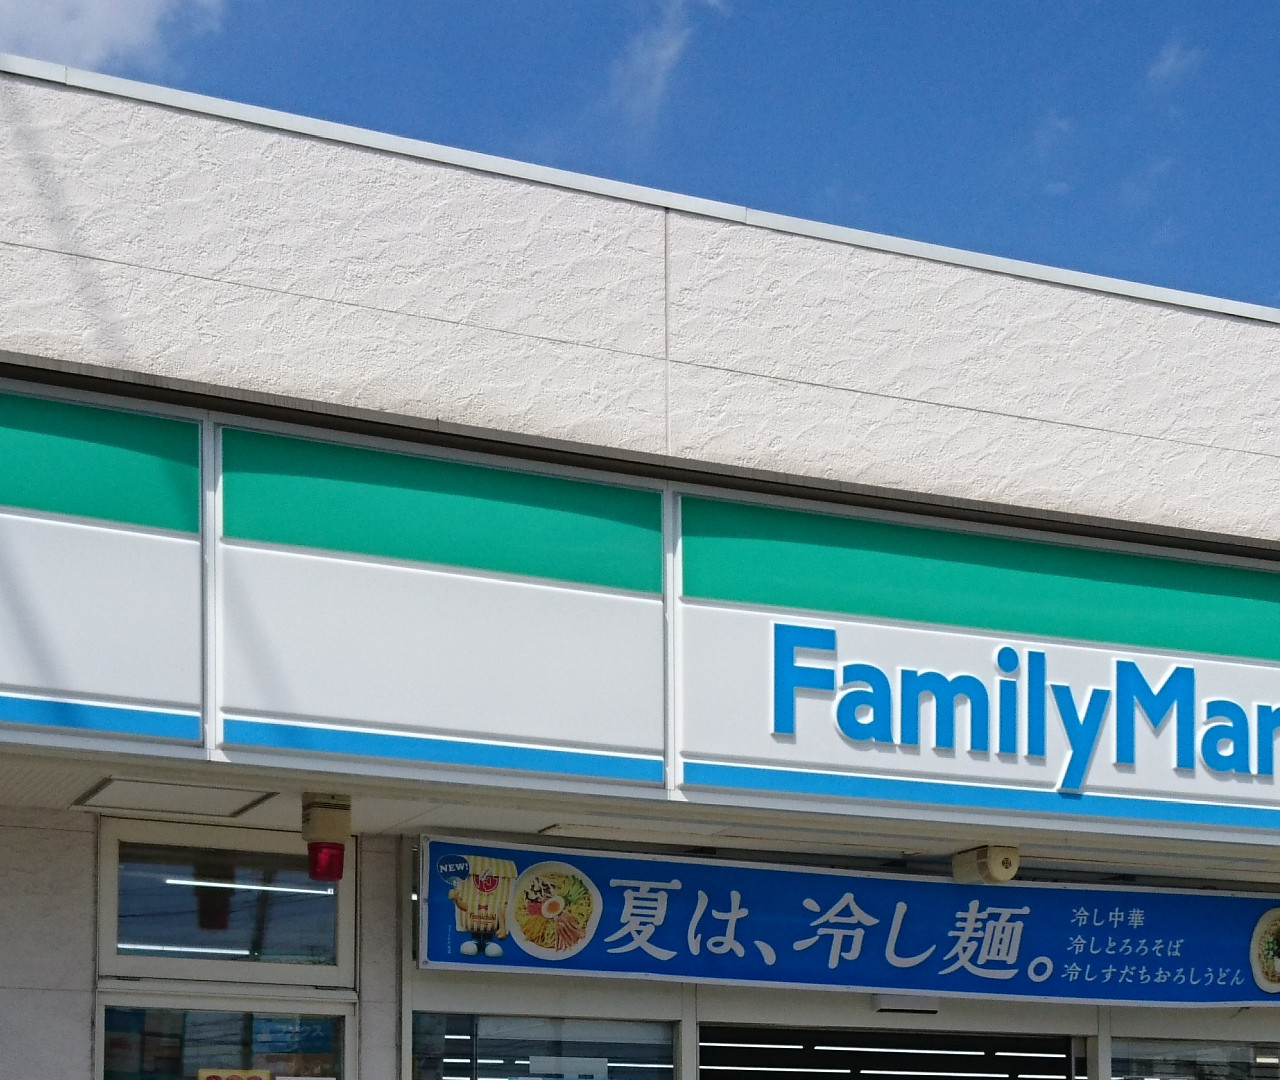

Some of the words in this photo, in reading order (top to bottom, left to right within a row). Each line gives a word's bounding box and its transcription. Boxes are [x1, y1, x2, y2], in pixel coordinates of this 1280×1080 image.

[439, 862, 470, 873] NEW!
[1070, 907, 1145, 929] 冷し中華
[604, 878, 1054, 983] 夏は、冷し麺。
[1066, 934, 1184, 958] 冷しとろろそば
[1061, 961, 1245, 986] 冷しすだちおろしうどん
